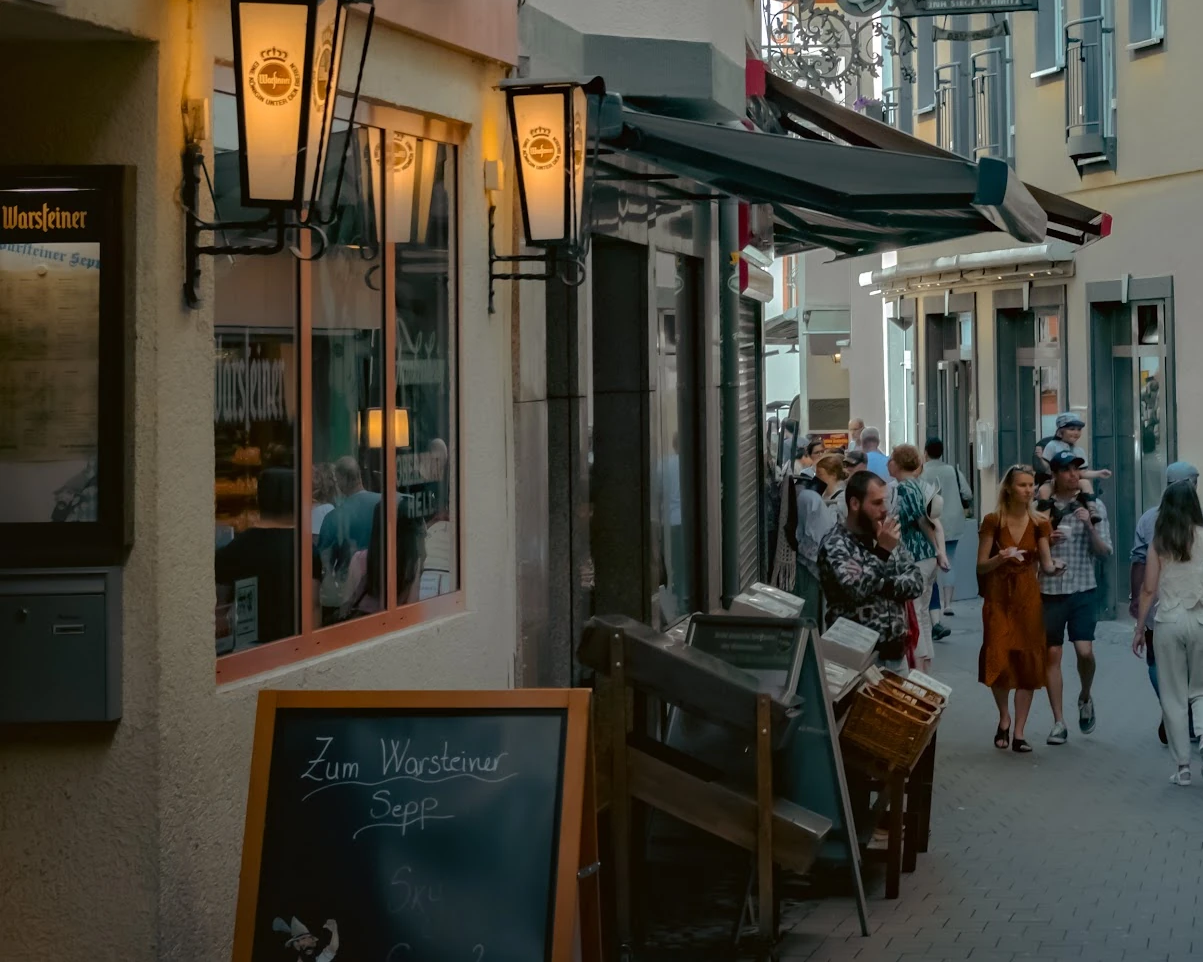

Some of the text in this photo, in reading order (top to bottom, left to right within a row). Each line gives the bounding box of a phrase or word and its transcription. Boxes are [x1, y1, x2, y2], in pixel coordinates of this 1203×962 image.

[2, 203, 87, 232] Warsteiner
[301, 736, 509, 782] Zum Warsteiner
[369, 789, 439, 837] Sepp
